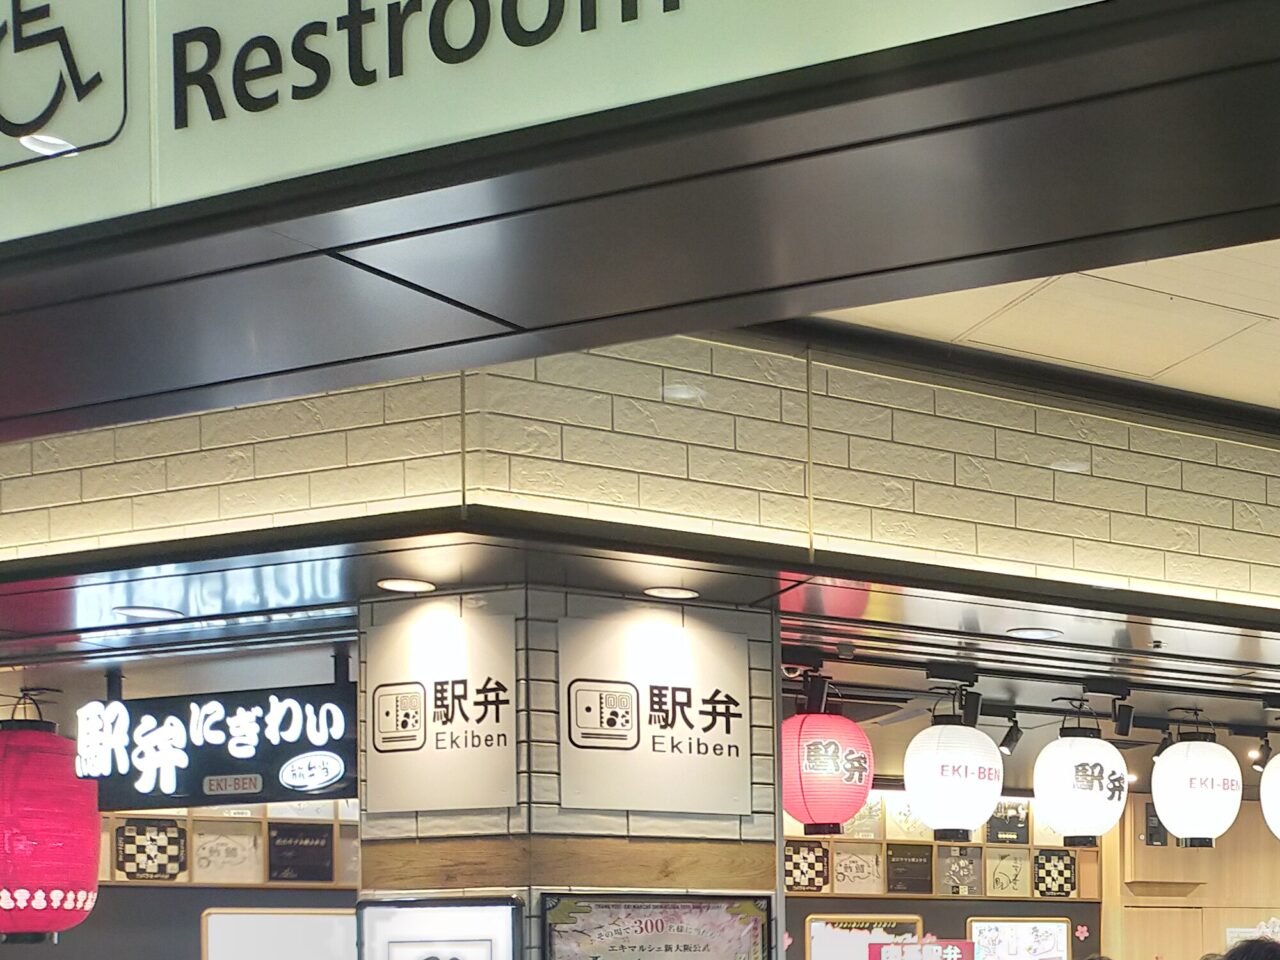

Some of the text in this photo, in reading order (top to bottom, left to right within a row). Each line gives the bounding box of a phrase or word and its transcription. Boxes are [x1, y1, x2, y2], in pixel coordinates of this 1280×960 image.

[432, 676, 510, 726] 駅弁
[648, 685, 743, 735] 駅弁
[76, 695, 345, 794] 駅弁にぎわい
[435, 730, 508, 750] Ekiben
[651, 735, 740, 758] Ekiben
[805, 740, 868, 784] 駅弁
[1073, 762, 1125, 801] 駅弁
[208, 777, 258, 792] EKI-BEN
